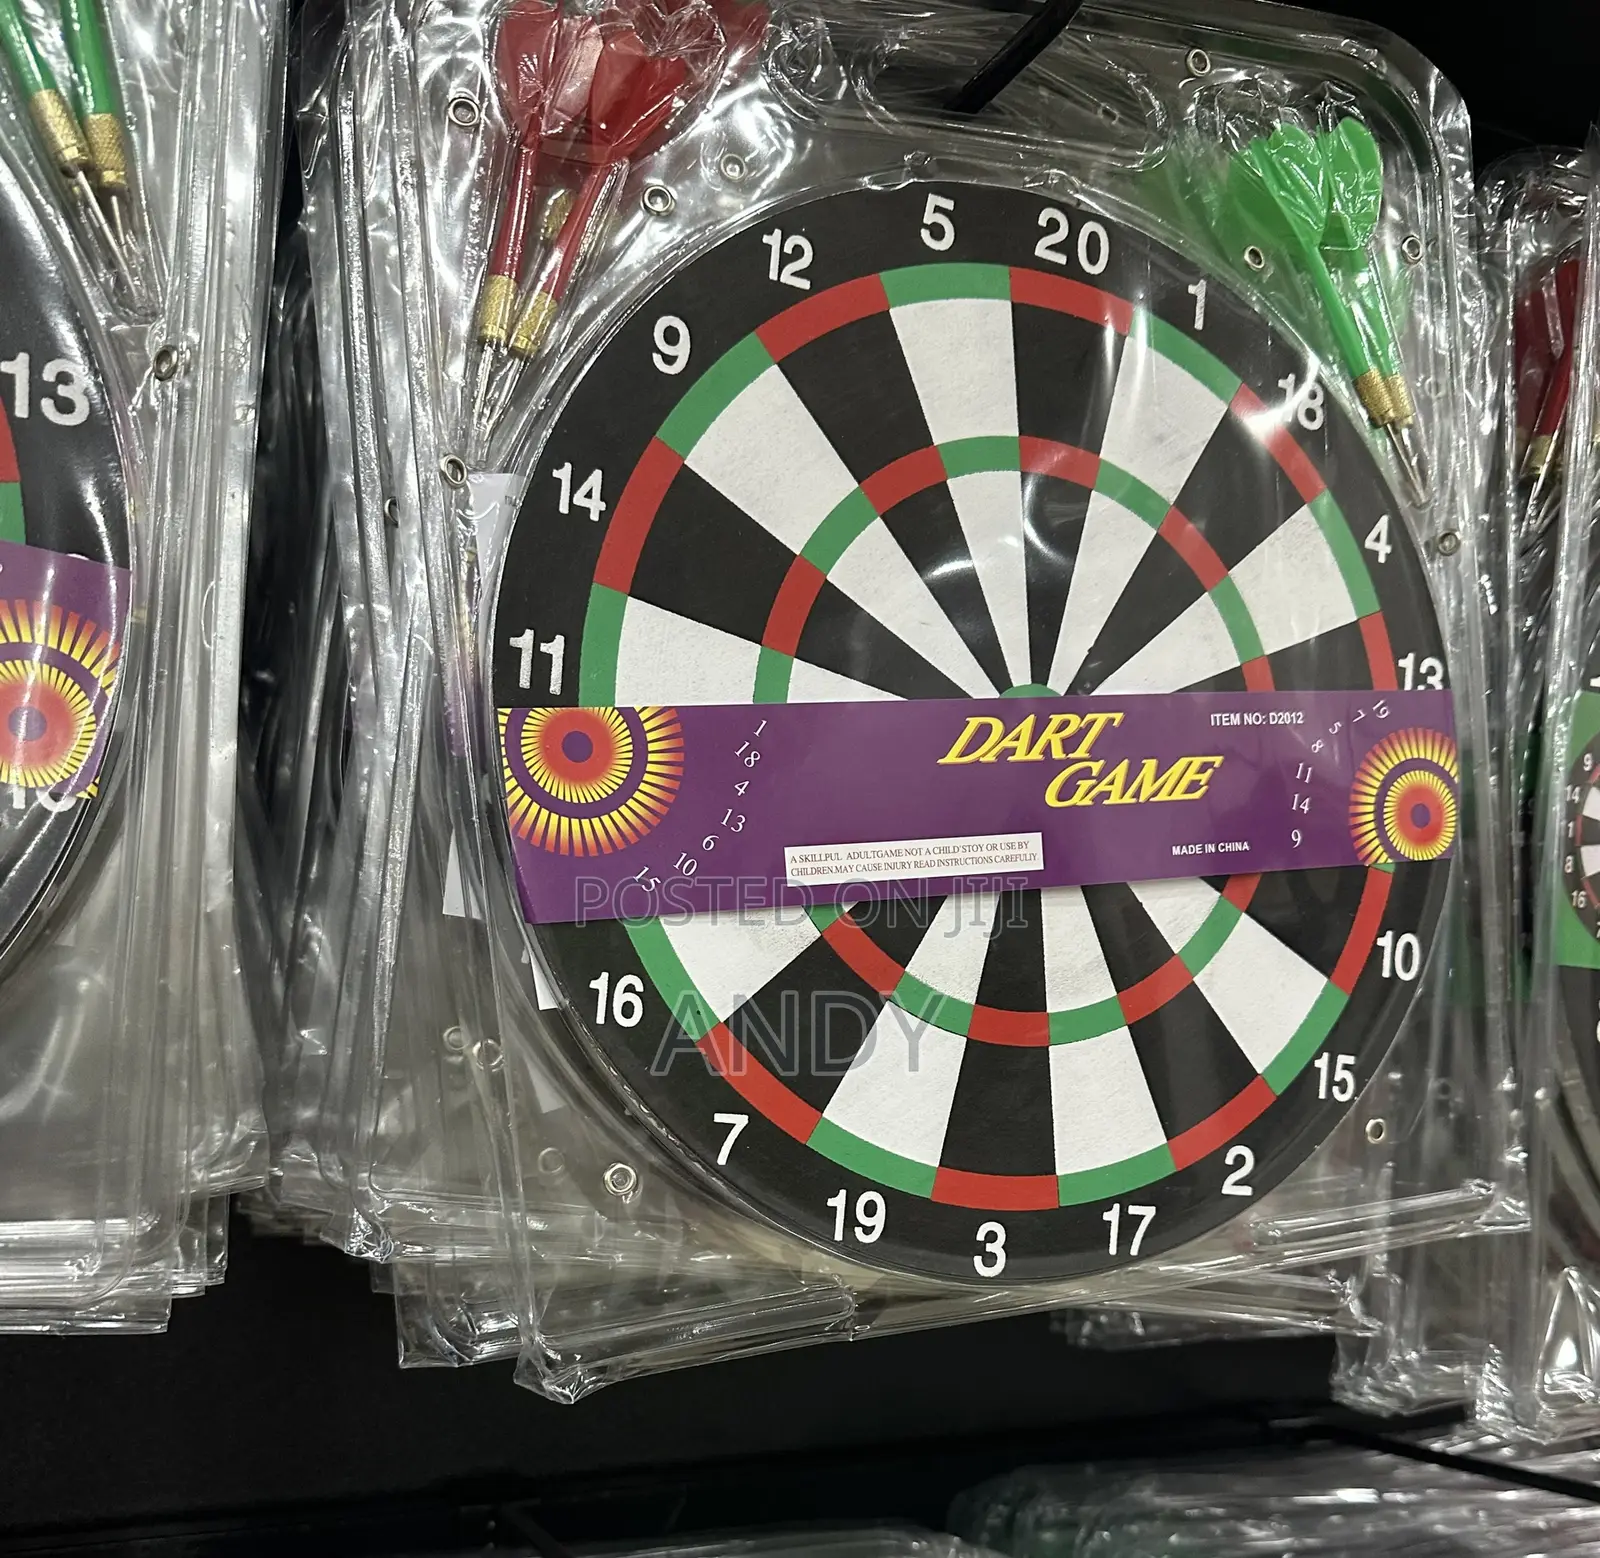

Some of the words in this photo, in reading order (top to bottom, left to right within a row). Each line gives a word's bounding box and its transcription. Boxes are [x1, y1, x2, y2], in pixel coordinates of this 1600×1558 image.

[921, 193, 955, 251] 5
[1034, 207, 1110, 275] 20
[762, 228, 814, 290] 12
[1187, 278, 1207, 331] 1
[653, 315, 691, 375] 9
[0, 352, 90, 427] 13
[1278, 373, 1325, 431] 18
[552, 462, 606, 522] 14
[1364, 514, 1392, 564] 4
[509, 628, 565, 696] 11
[1397, 652, 1443, 691] 13
[753, 719, 768, 738] 1
[936, 712, 1125, 765] DART
[1210, 713, 1241, 727] ITEM
[1243, 712, 1267, 726] NO:
[1269, 711, 1305, 726] D2012
[1352, 708, 1367, 723] 7
[734, 740, 761, 768] 18
[1311, 738, 1325, 754] 8
[1583, 753, 1593, 772] 9
[734, 780, 751, 797] 4
[1045, 755, 1225, 808] GAME
[1295, 762, 1313, 784] 11
[1564, 785, 1581, 803] 14
[720, 807, 746, 833] 13
[1291, 793, 1311, 814] 14
[673, 851, 698, 877] 10
[702, 834, 720, 852] 6
[790, 855, 798, 864] A
[904, 847, 924, 858] NOT
[924, 847, 932, 856] A
[985, 843, 998, 852] OR
[999, 841, 1017, 851] USE
[1017, 840, 1030, 850] BY
[1172, 843, 1203, 856] MADE
[1204, 842, 1216, 854] IN
[1217, 841, 1250, 853] CHINA
[1291, 829, 1302, 849] 9
[632, 866, 662, 892] 15
[855, 862, 884, 873] CAUSE
[883, 860, 913, 871] INJURY
[913, 859, 936, 869] READ
[936, 856, 994, 868] INSTRUCTIONS
[1376, 931, 1421, 981] 10
[589, 971, 644, 1028] 16
[1314, 1052, 1356, 1102] 15
[713, 1113, 749, 1166] 7
[1221, 1145, 1255, 1197] 2
[826, 1188, 886, 1244] 19
[1102, 1202, 1157, 1256] 17
[973, 1221, 1007, 1278] 3
